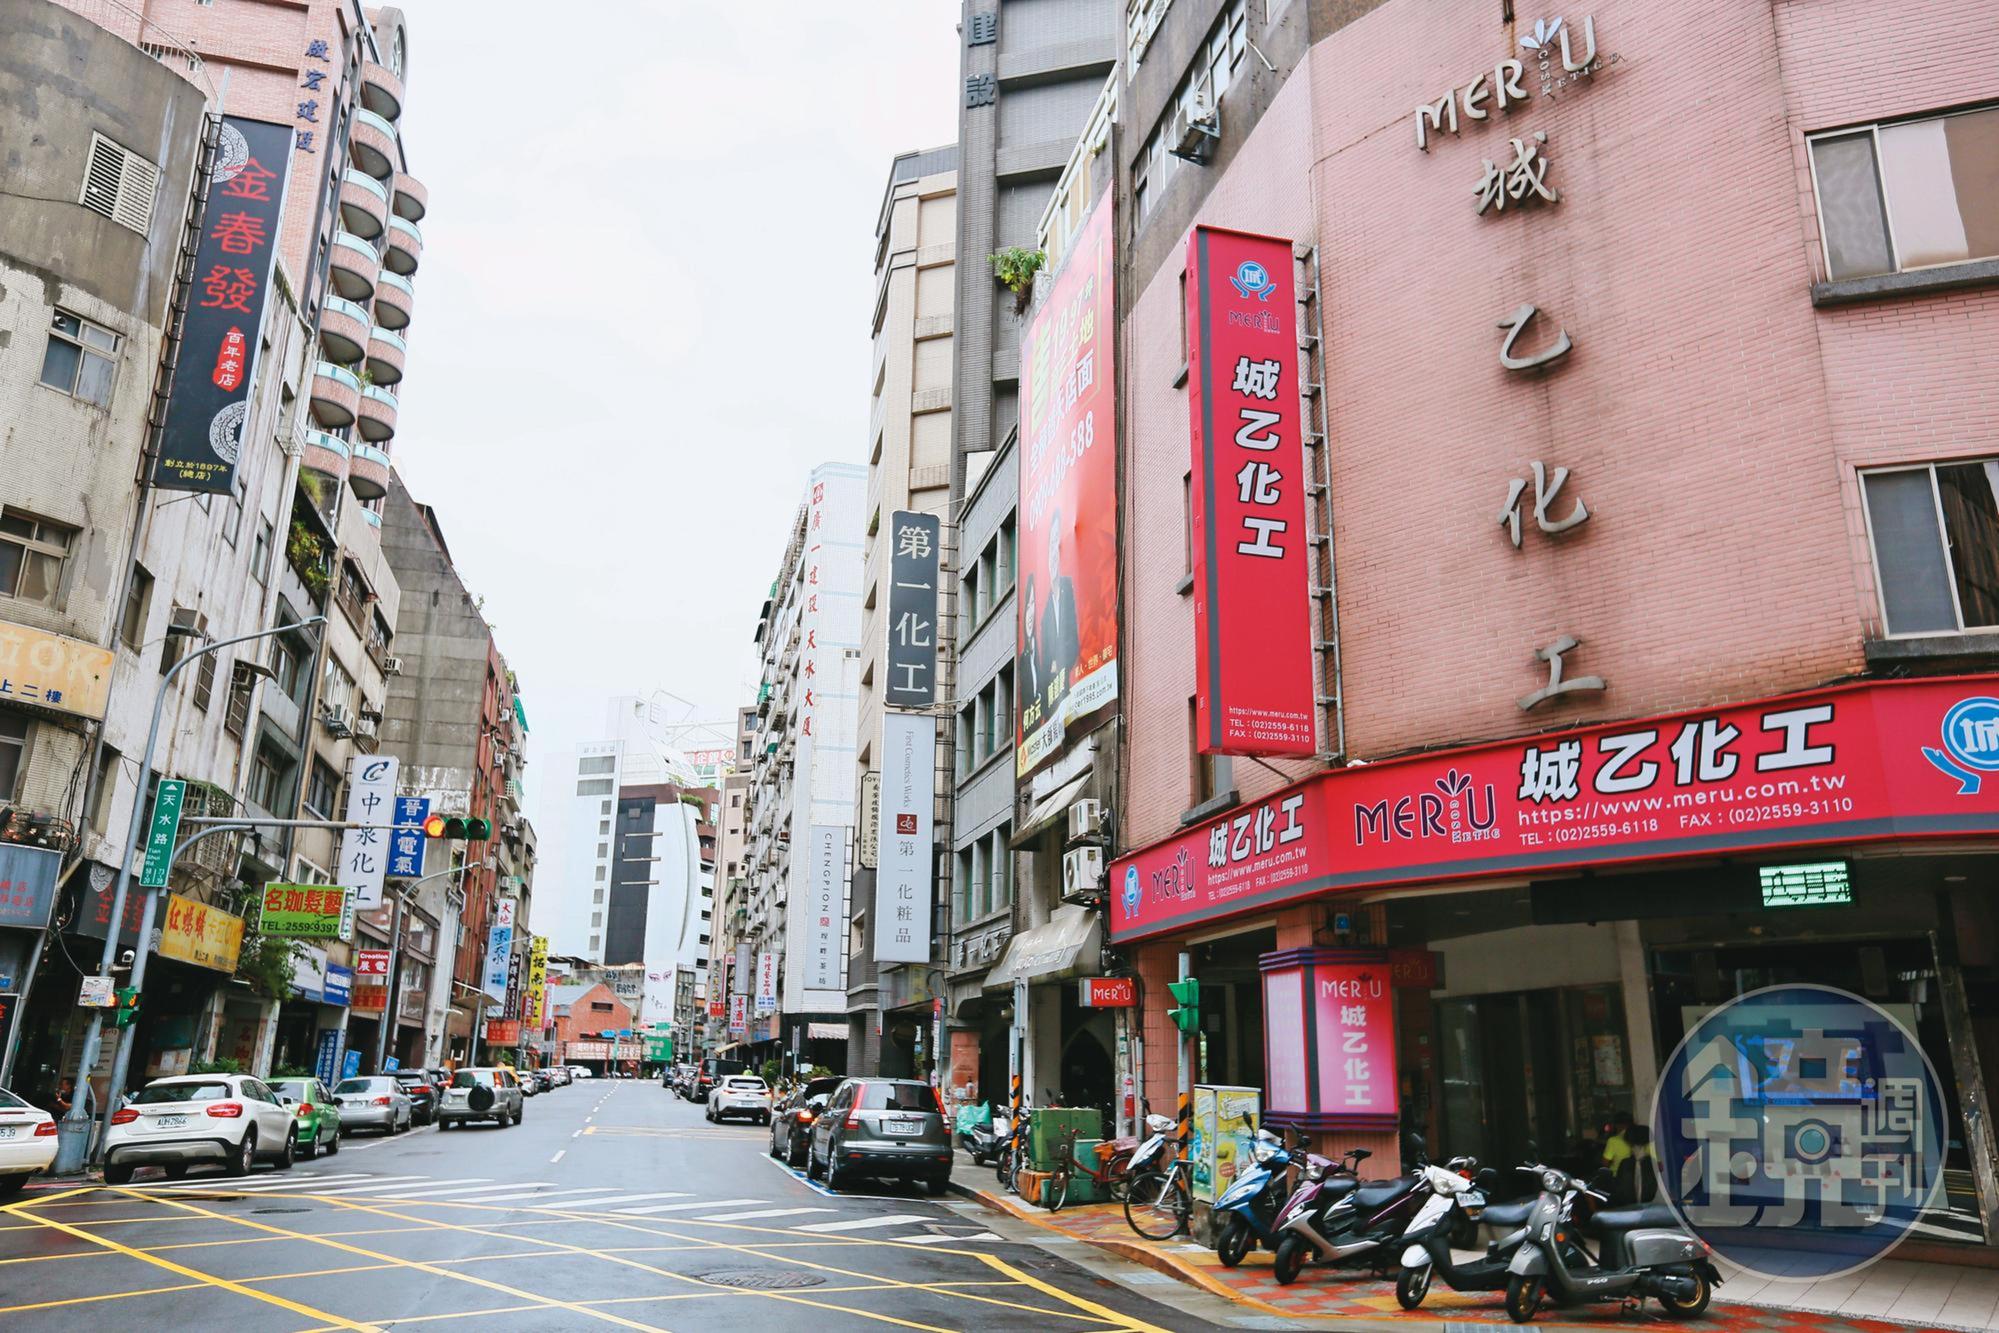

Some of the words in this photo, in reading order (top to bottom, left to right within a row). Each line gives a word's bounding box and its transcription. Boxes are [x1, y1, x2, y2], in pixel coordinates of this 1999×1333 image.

[966, 12, 997, 109] 建設
[1415, 15, 1597, 149] MERU
[200, 157, 278, 314] 金春發
[217, 331, 245, 387] 百年老店
[1229, 310, 1279, 331] MERU
[1232, 356, 1287, 559] 城乙化工
[1472, 131, 1607, 711] 城乙化工
[893, 525, 931, 693] 第一化工
[1228, 706, 1309, 720] https://www.meru.com.tw
[1517, 703, 1835, 805] 城乙化工
[154, 794, 177, 845] 天水路
[1207, 792, 1305, 869] 城乙化工
[1354, 784, 1497, 846] MERU
[1518, 773, 1847, 827] https://www.meru.com.tw
[1555, 819, 1659, 844] (02)2559-6118
[1728, 797, 1853, 826] (02)2559-3110
[351, 791, 382, 902] 中泉化工
[822, 832, 832, 912] CHENGPION
[895, 840, 914, 943] 第一化粧品
[1093, 987, 1131, 1001] MERU
[1321, 979, 1382, 998] MERU
[1340, 1005, 1372, 1106] 城乙化工
